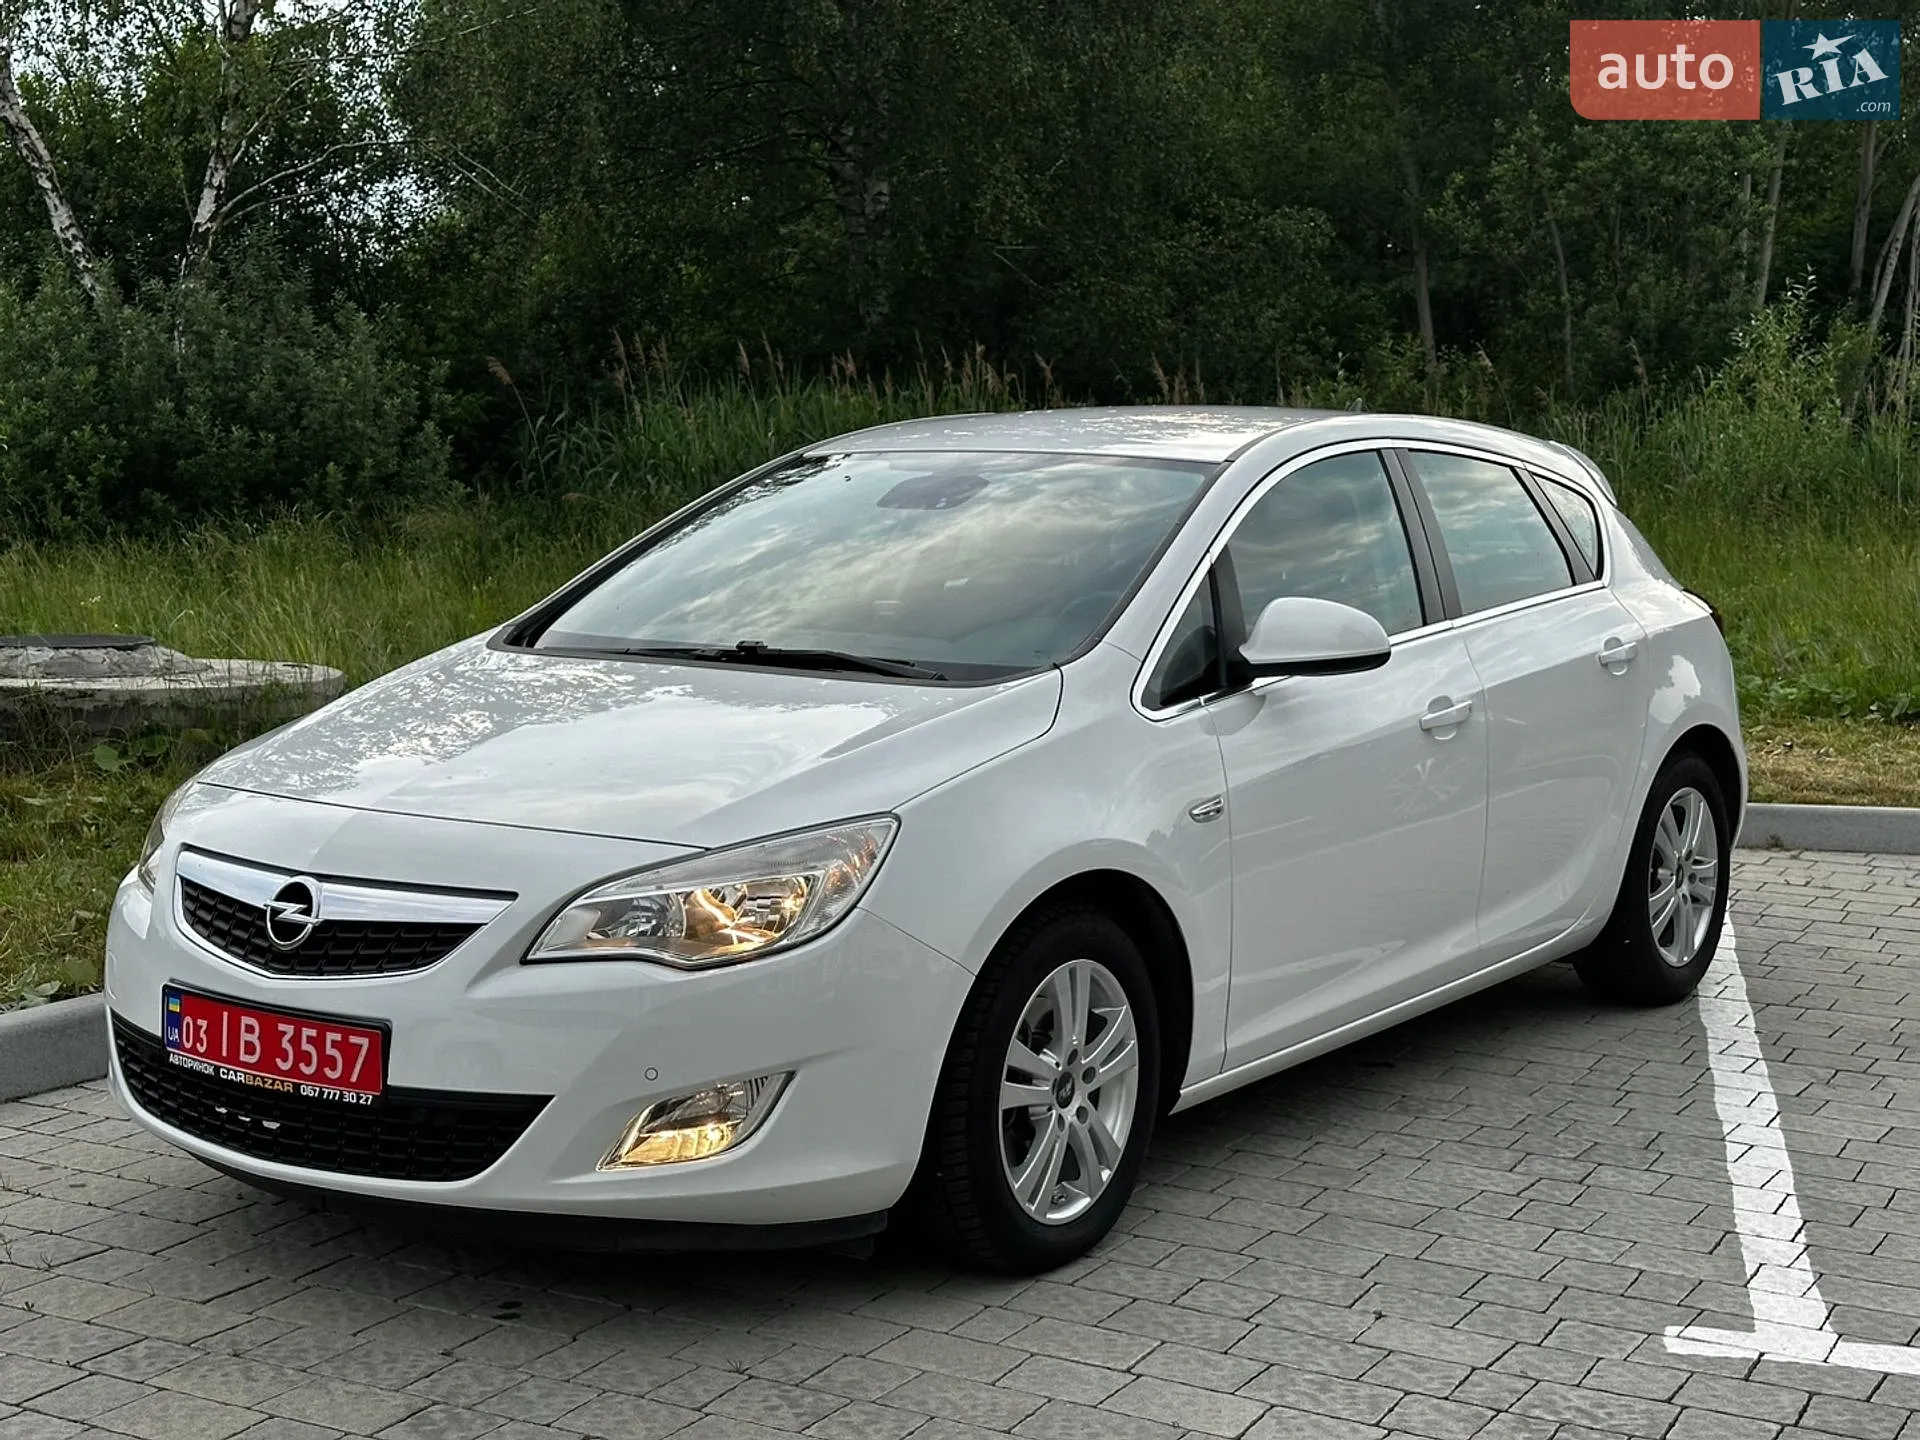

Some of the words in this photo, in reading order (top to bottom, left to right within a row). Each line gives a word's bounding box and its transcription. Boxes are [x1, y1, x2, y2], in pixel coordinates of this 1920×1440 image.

[168, 1026, 180, 1042] UA
[182, 1015, 208, 1053] 03
[222, 1011, 261, 1064] IB
[275, 1022, 369, 1083] 3557
[169, 1053, 215, 1076] АВТОРИНОК
[219, 1067, 294, 1093] CARBAZAR
[300, 1084, 320, 1097] 067
[321, 1087, 340, 1101] 777
[342, 1090, 357, 1103] 30
[359, 1093, 373, 1106] 27
